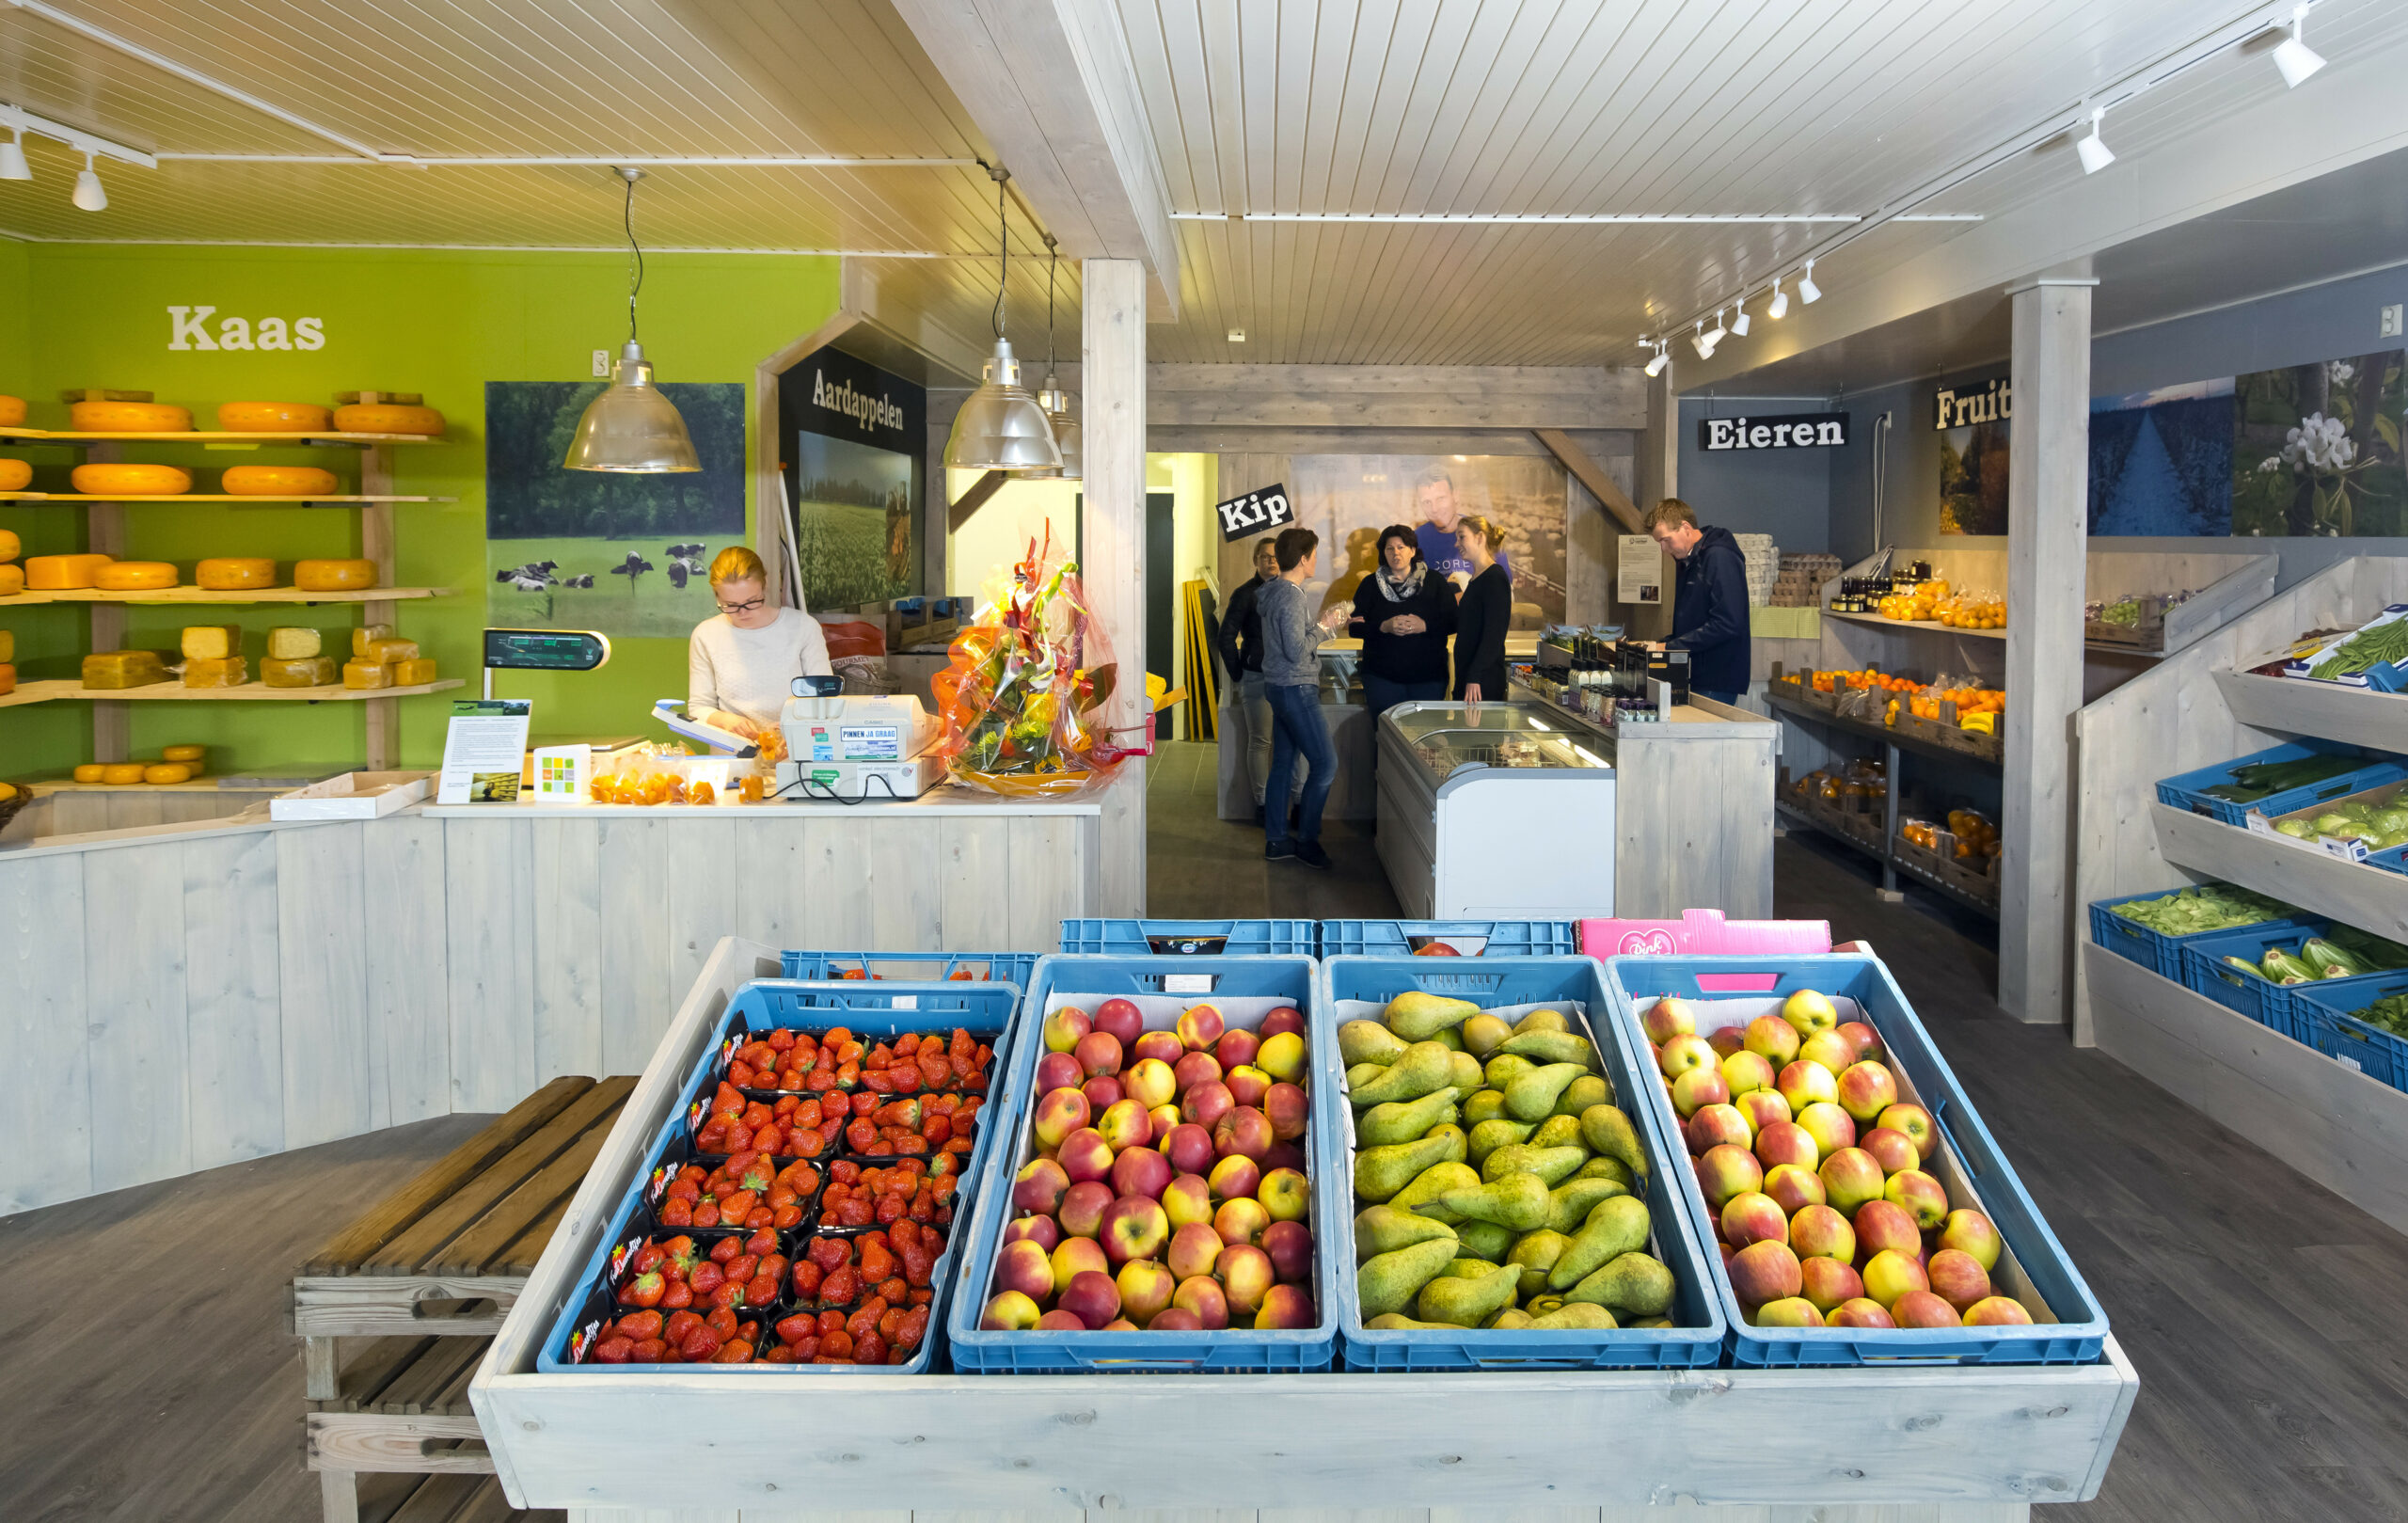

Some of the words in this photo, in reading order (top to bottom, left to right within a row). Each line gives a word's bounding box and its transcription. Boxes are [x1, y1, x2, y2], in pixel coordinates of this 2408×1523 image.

[166, 306, 325, 351] Kaas
[813, 368, 903, 432] Aardappelen
[1937, 379, 2011, 430] Fruit
[1707, 417, 1845, 450] Eieren
[1218, 494, 1288, 532] Kip
